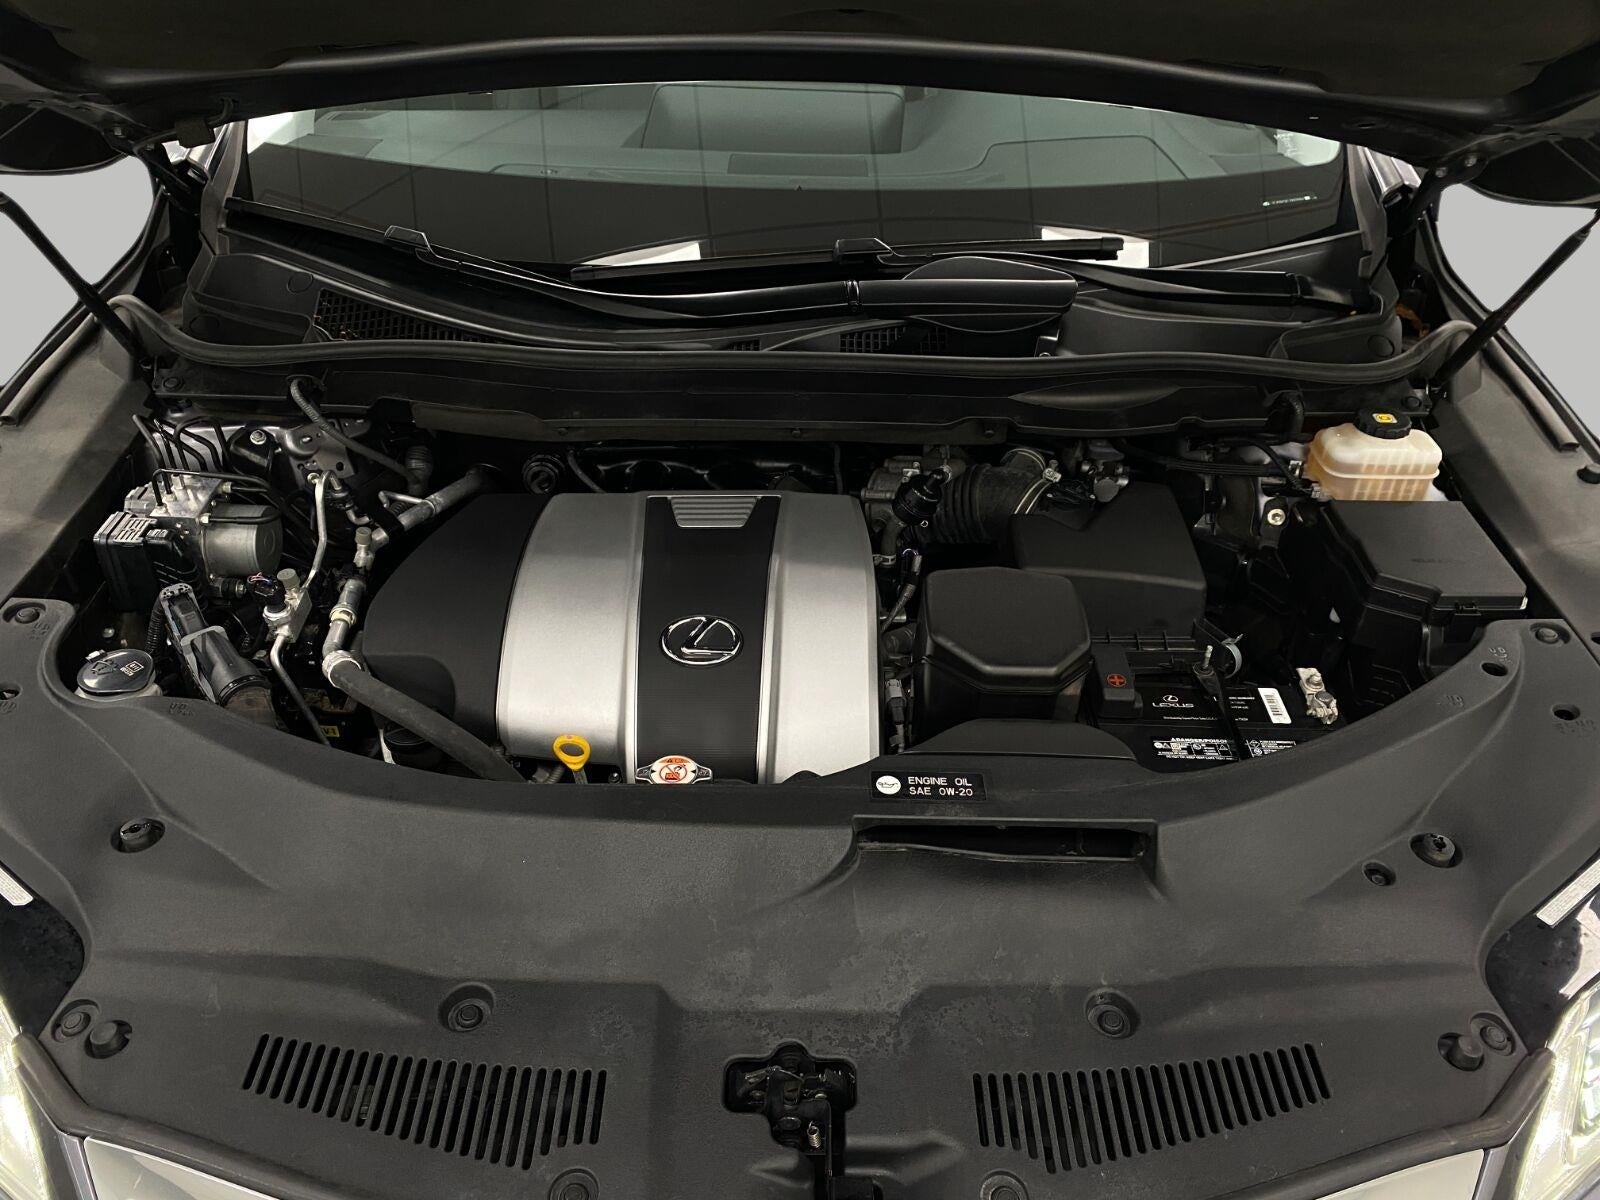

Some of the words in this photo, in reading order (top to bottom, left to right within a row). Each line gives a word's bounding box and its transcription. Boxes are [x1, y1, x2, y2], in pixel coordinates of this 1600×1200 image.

[908, 776, 947, 786] ENGINE
[954, 777, 972, 786] OIL
[909, 787, 932, 796] SAE
[938, 787, 973, 797] 0W-20
